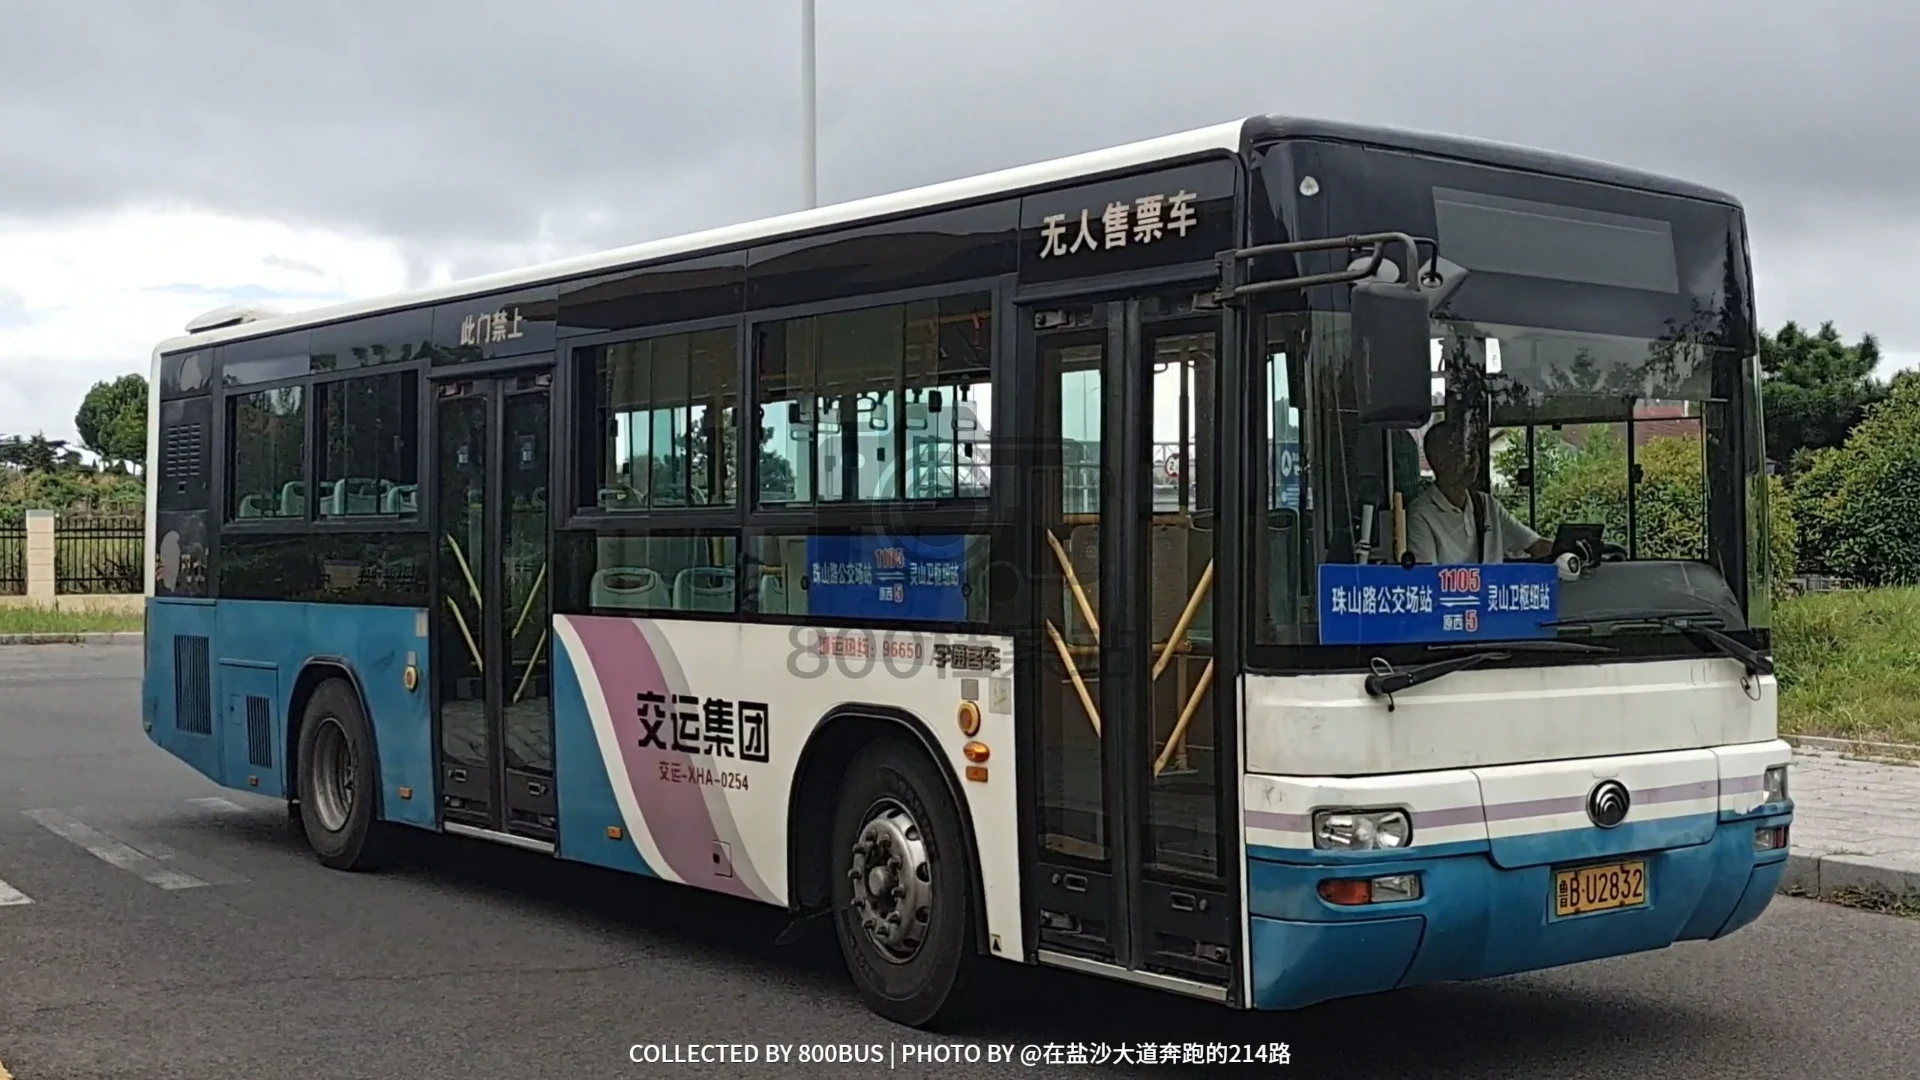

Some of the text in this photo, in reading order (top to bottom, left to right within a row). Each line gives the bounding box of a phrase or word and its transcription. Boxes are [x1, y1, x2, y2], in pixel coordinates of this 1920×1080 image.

[1039, 189, 1197, 259] 无人售票车
[460, 306, 523, 346] 此门禁上
[1438, 567, 1481, 593] 1105
[1331, 583, 1550, 616] 珠山路公交场站 灵山卫枢纽站
[636, 690, 770, 764] 交运集团
[658, 760, 750, 792] 交运-XHA-0254
